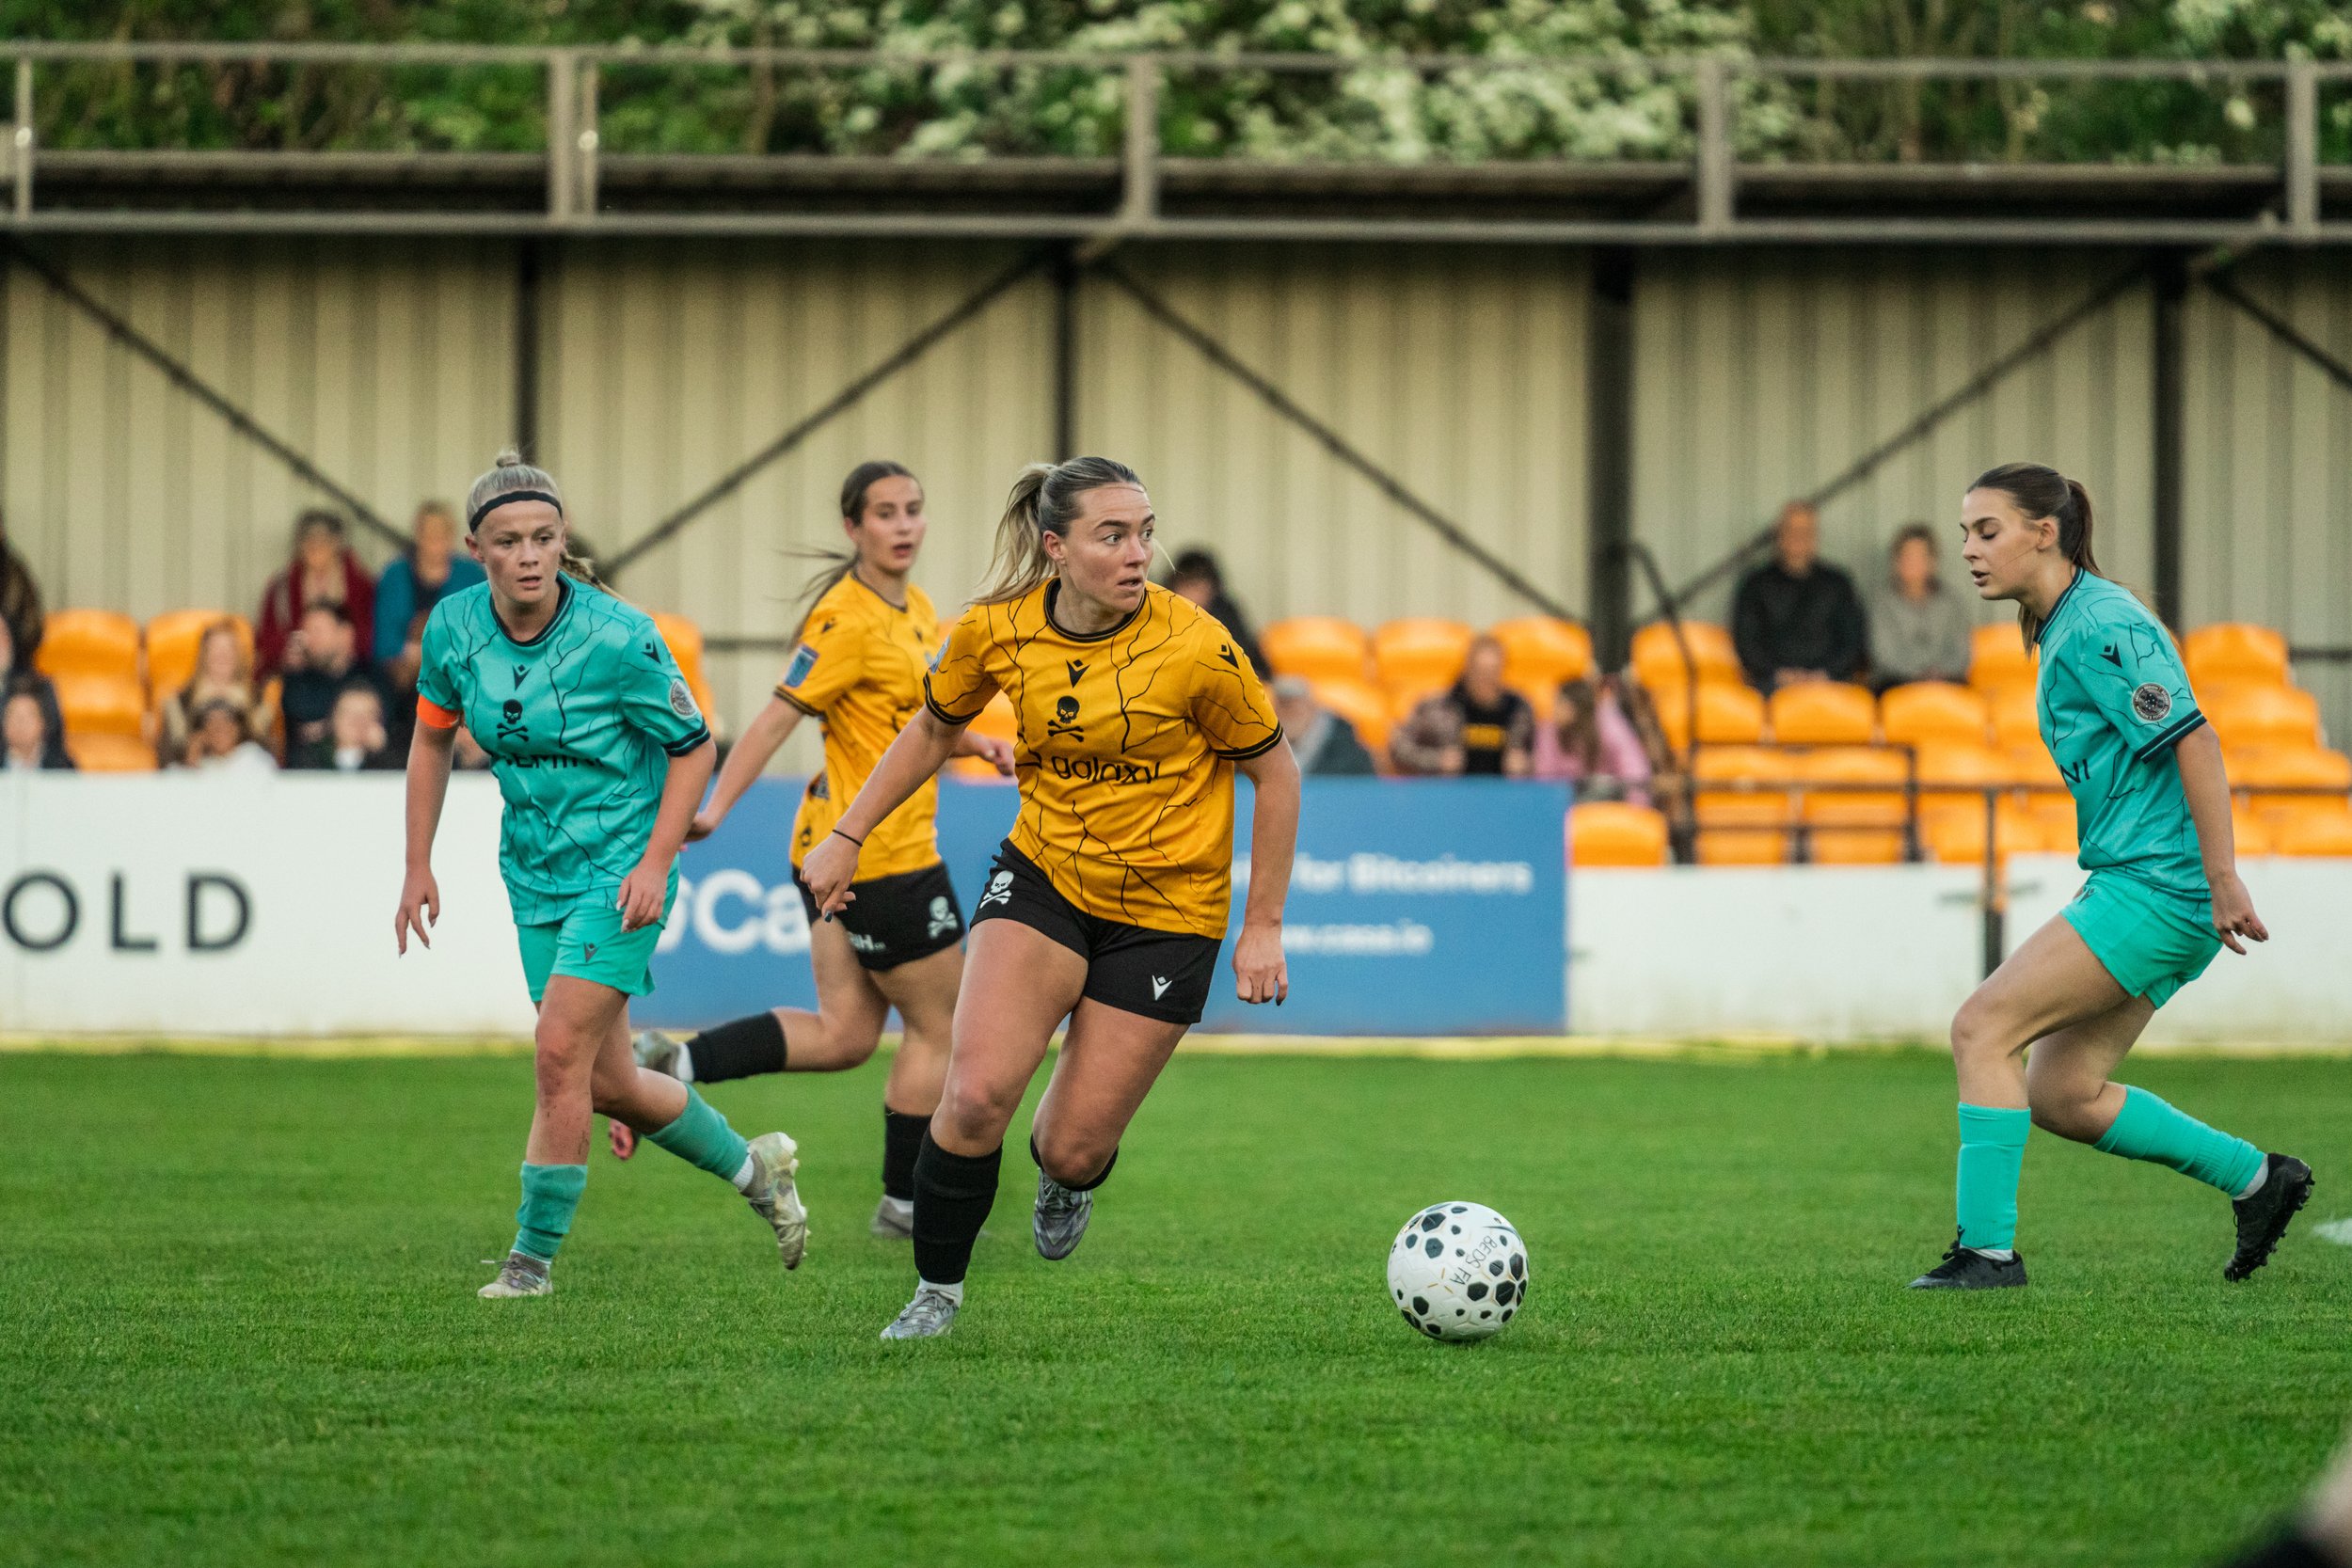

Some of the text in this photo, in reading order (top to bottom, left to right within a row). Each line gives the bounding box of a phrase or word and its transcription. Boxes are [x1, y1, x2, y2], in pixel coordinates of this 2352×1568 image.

[1347, 852, 1533, 893] Bitcoiners
[2, 872, 250, 951] OLD
[1449, 1266, 1471, 1285] FA
